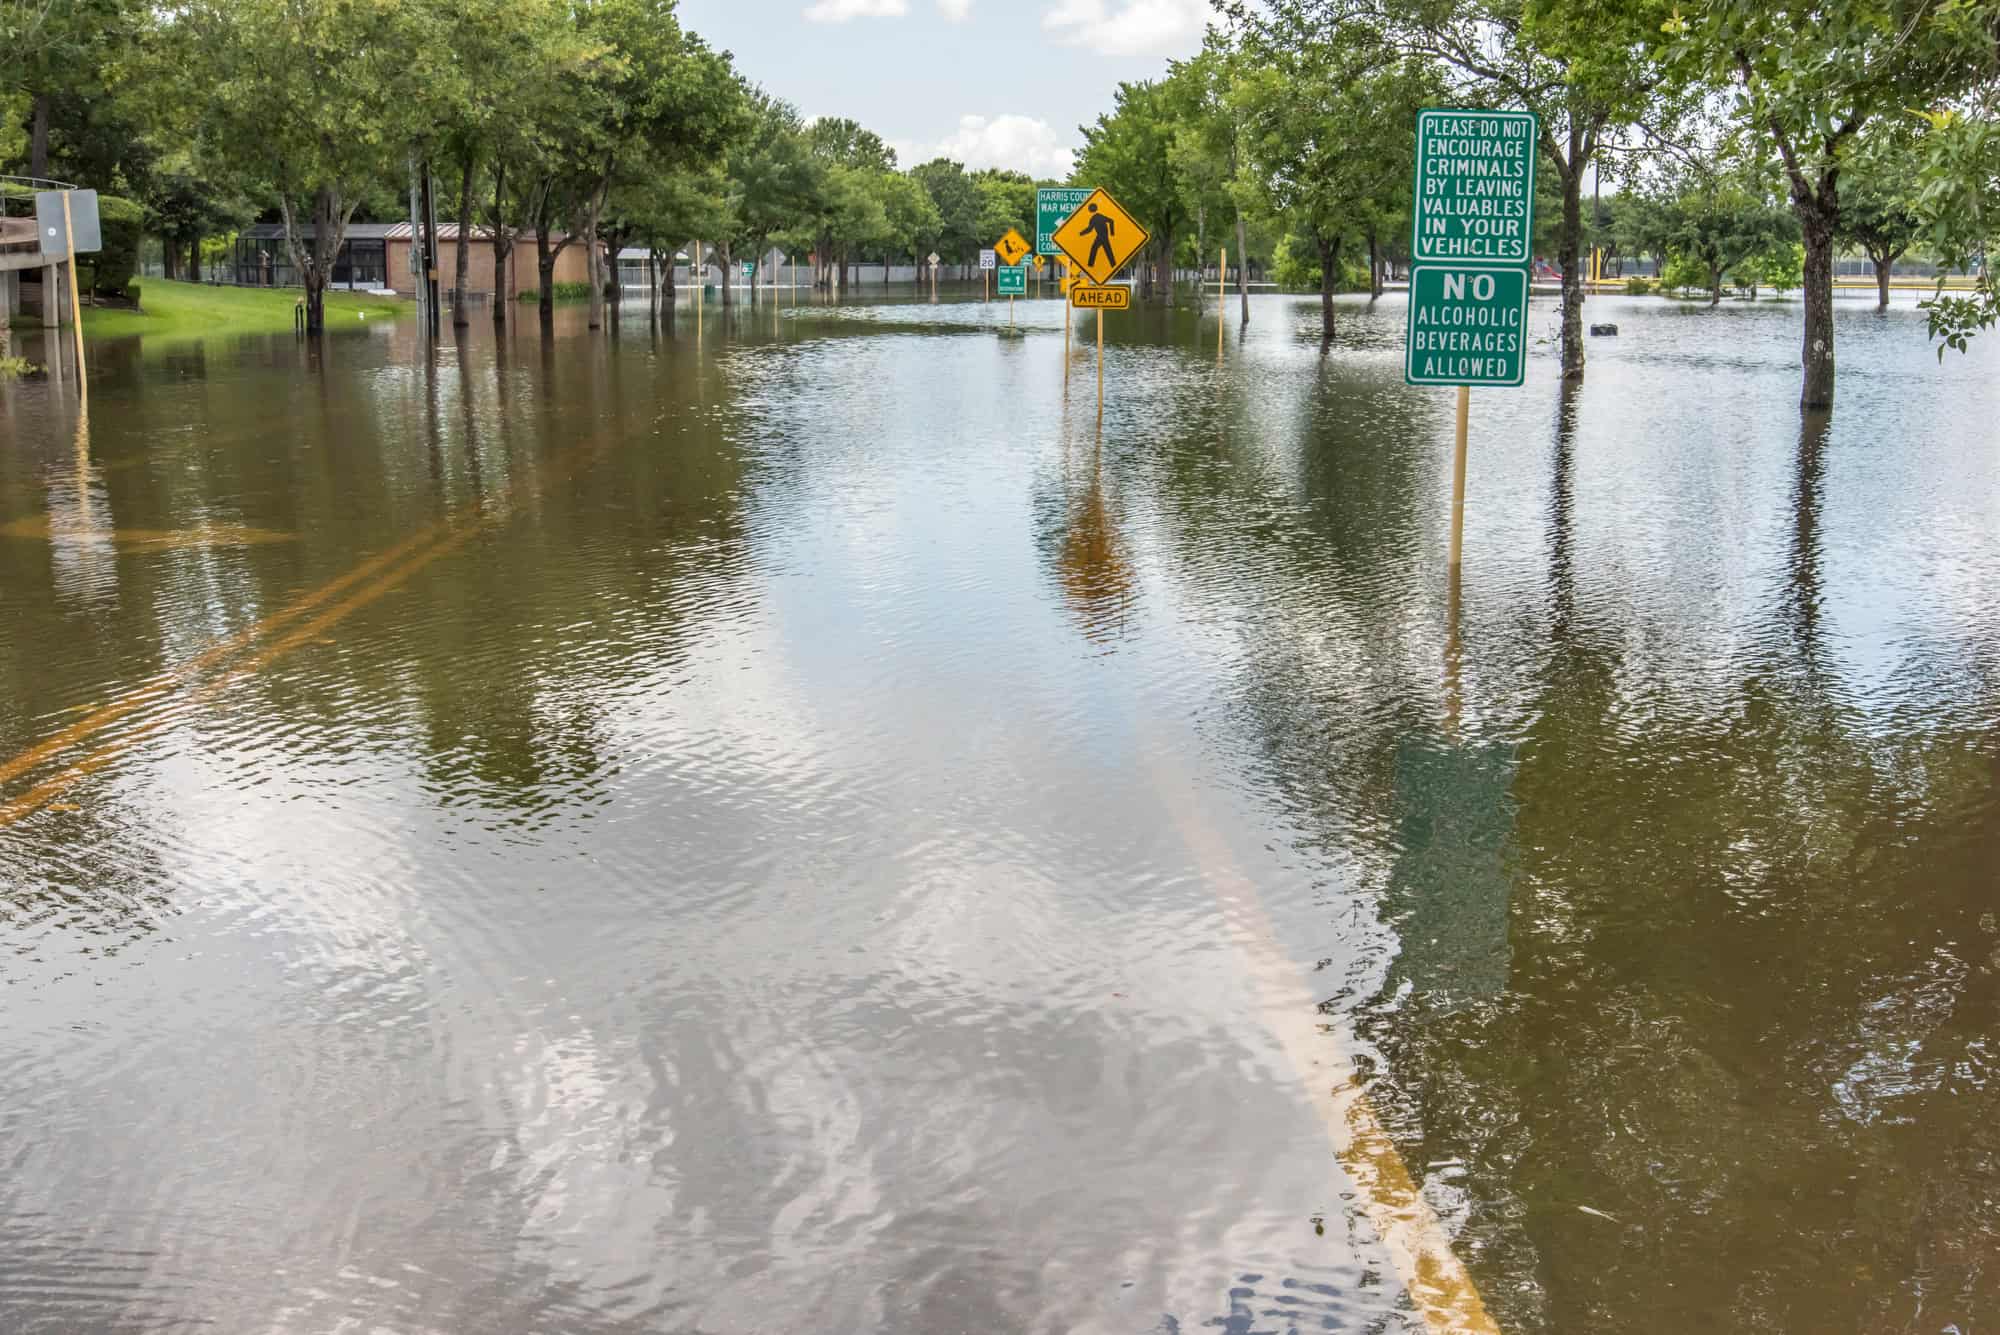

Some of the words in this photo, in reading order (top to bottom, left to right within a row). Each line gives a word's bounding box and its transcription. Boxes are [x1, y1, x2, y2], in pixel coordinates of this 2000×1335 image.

[1425, 118, 1476, 137] PLEASE
[1480, 120, 1498, 137] DO
[1503, 121, 1528, 138] NOT
[1427, 138, 1524, 158] ENCOURAGE
[1426, 158, 1524, 177] CRIMINALS
[1040, 192, 1068, 201] HARRIS
[1426, 178, 1447, 195] BY
[1456, 179, 1522, 197] LEAVING
[1041, 203, 1058, 213] WAR
[1423, 198, 1525, 217] VALUABLES
[1425, 217, 1446, 234] IN
[1461, 218, 1519, 236] YOUR
[1421, 237, 1522, 256] VEHICLES
[1443, 273, 1495, 300] NO
[1079, 292, 1122, 303] AHEAD
[1417, 306, 1518, 327] ALCOHOLIC
[1416, 331, 1517, 352] BEVERAGES
[1424, 356, 1507, 377] ALLOWED
